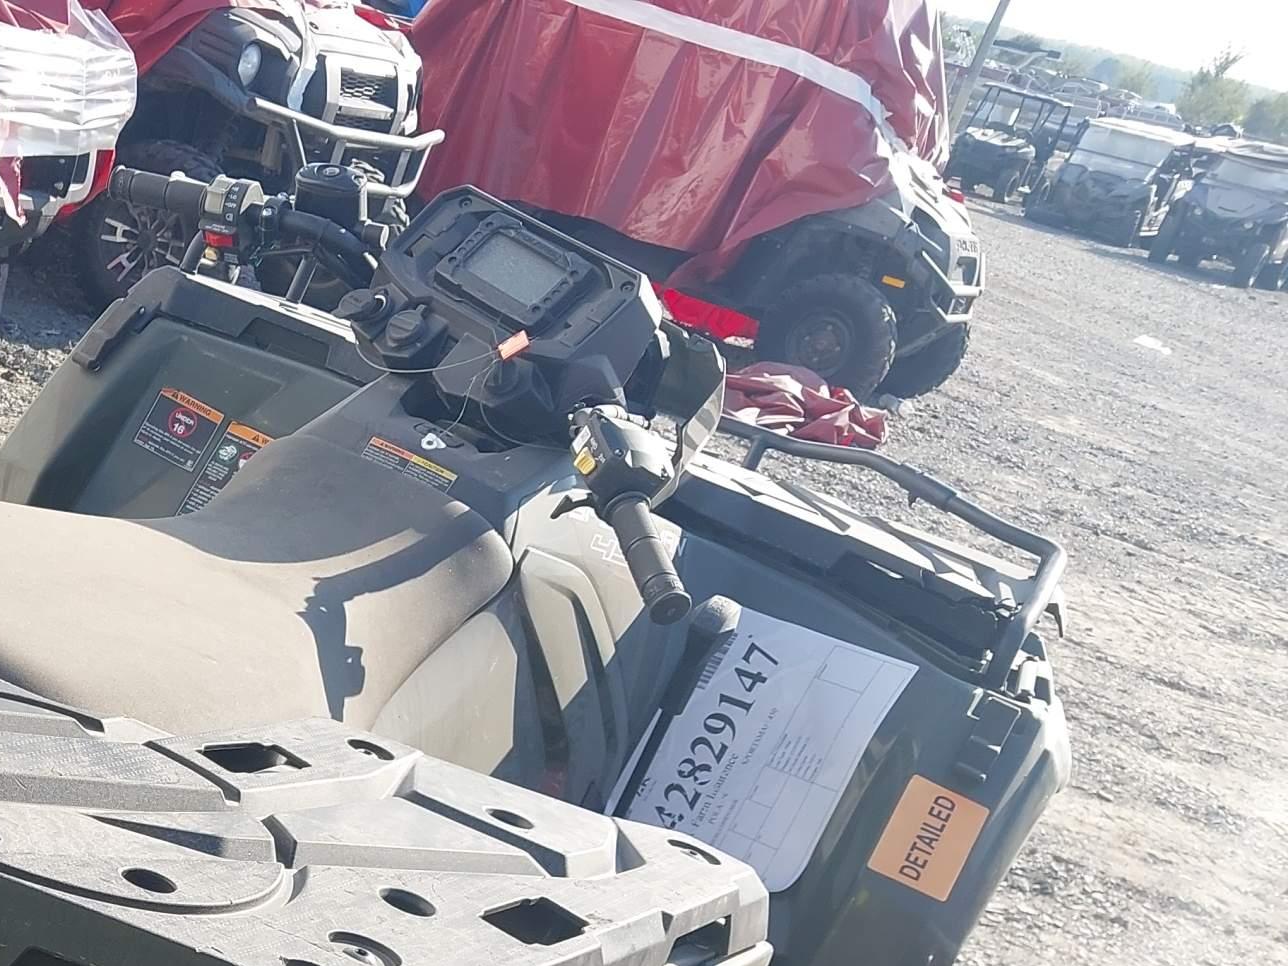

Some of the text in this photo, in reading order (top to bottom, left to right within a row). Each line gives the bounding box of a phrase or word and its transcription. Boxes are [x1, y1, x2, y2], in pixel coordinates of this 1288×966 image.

[172, 422, 185, 435] 16
[179, 394, 212, 418] WARNING
[652, 641, 780, 830] 42829147
[899, 794, 957, 882] DETAILED
